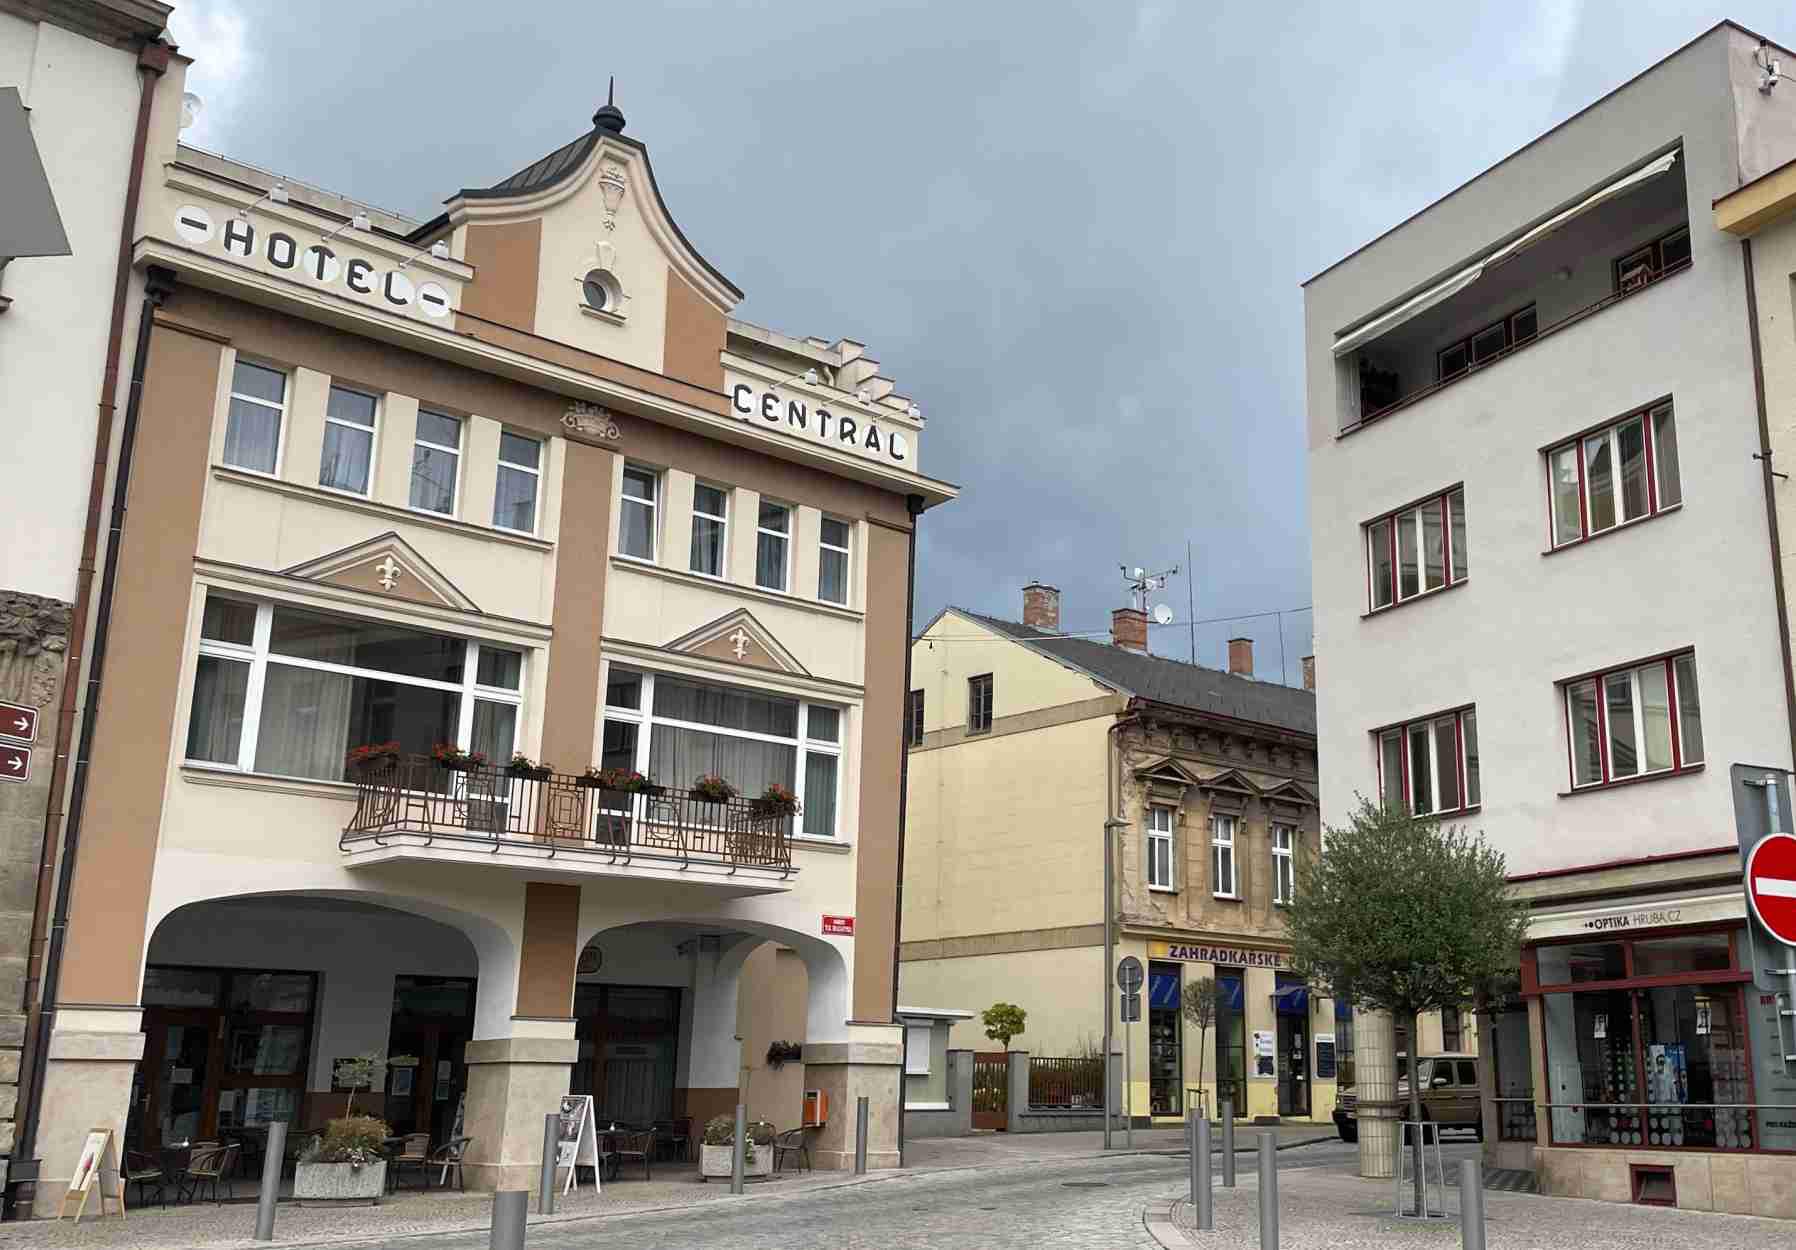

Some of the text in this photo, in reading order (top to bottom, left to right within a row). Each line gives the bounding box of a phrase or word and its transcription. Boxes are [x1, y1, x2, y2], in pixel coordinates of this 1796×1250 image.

[223, 219, 408, 306] HOTEL
[733, 383, 905, 461] CENTRAL
[1594, 915, 1630, 930] OPTIKA
